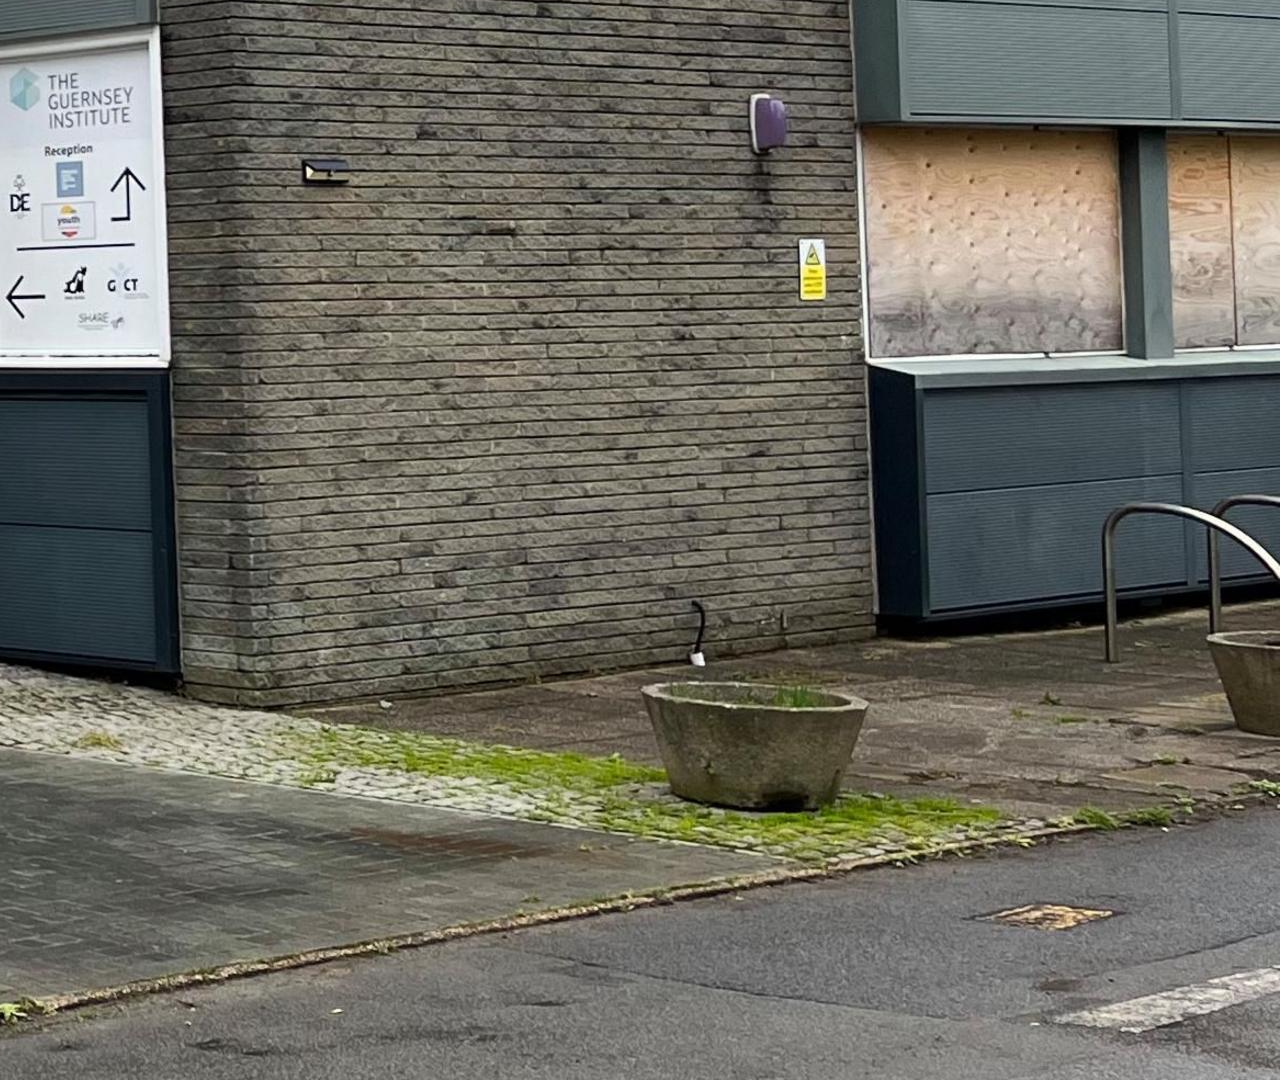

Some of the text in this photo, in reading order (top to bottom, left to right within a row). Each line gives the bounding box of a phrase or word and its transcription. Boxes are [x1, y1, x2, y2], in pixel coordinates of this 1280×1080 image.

[47, 72, 79, 90] THE
[48, 86, 134, 110] GUERNSEY
[48, 106, 131, 129] INSTITUTE
[44, 145, 93, 157] Reception
[57, 216, 81, 226] youth
